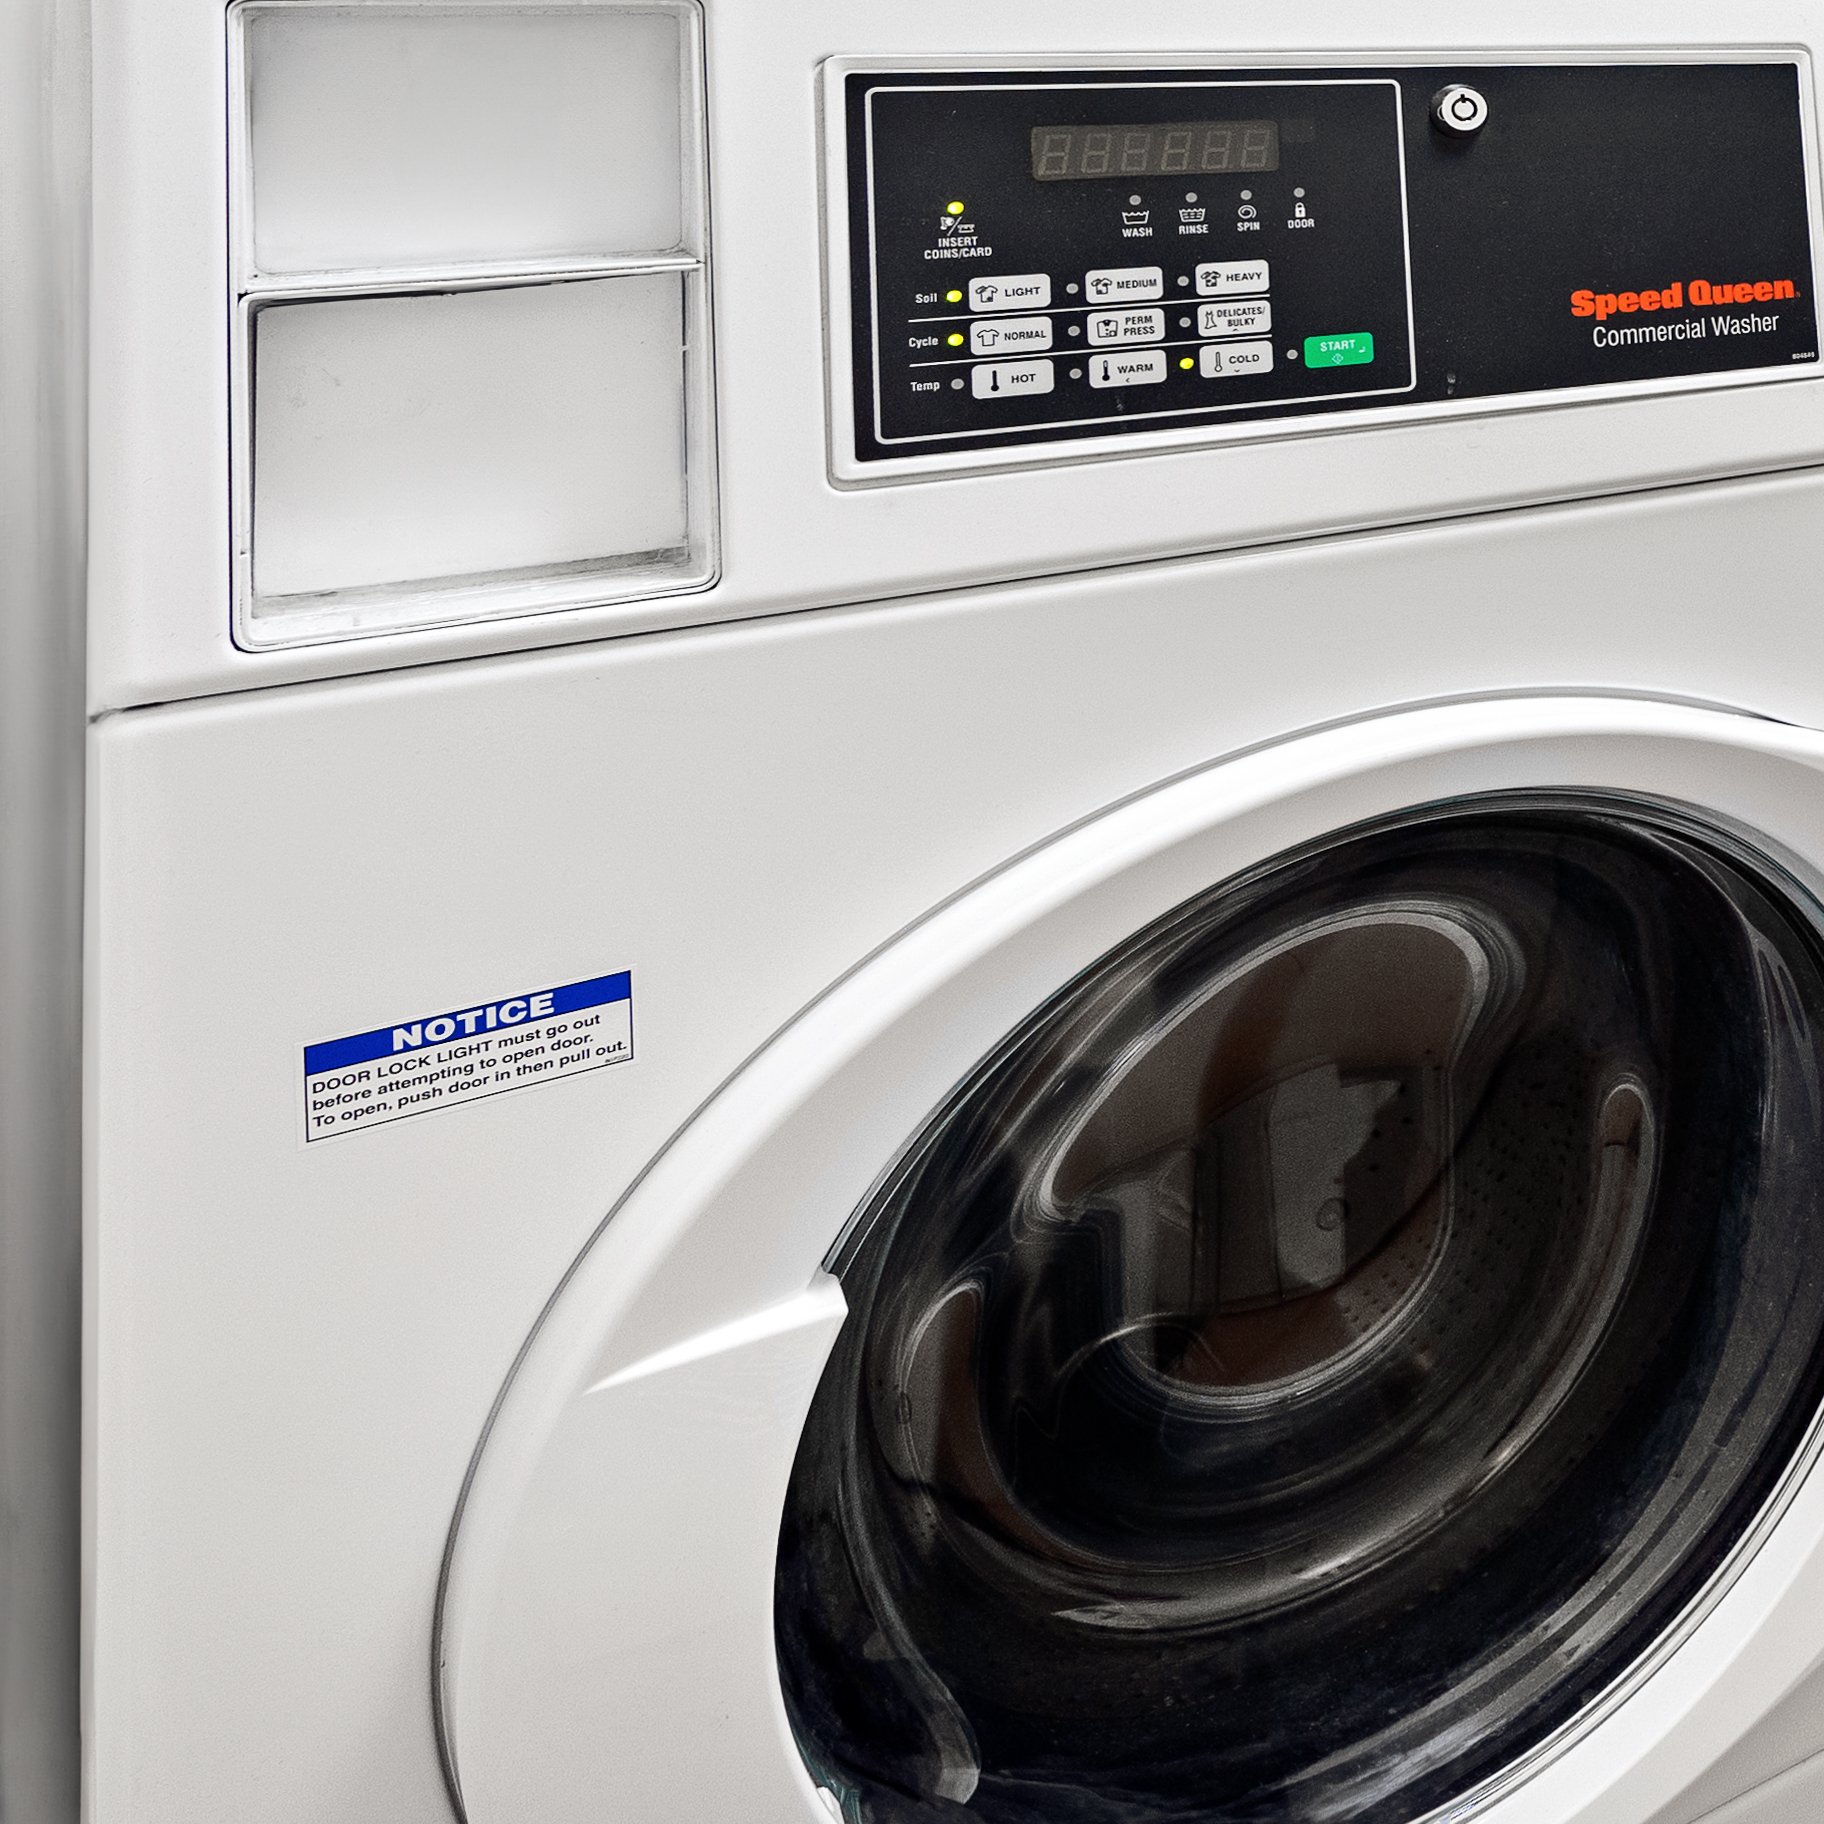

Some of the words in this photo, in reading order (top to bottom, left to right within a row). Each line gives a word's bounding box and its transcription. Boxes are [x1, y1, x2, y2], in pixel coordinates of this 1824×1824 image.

[1178, 223, 1209, 235] RINSE
[1236, 220, 1260, 232] SPIN
[1287, 218, 1315, 229] DOOR
[1121, 226, 1153, 238] WASH
[938, 236, 979, 248] INSERT
[924, 247, 993, 260] COINS/CARD
[1226, 271, 1263, 282] HEAVY
[1116, 278, 1158, 290] MEDIUM
[915, 292, 938, 304] Soil
[1004, 286, 1041, 298] LIGHT
[1570, 282, 1683, 320] Speed
[1688, 279, 1794, 307] Queen
[1216, 306, 1266, 319] DELICATES/
[1125, 315, 1153, 325] PERM
[1227, 317, 1257, 327] BULKY
[1004, 329, 1047, 341] NORMAL
[1123, 326, 1155, 336] PRESS
[1593, 317, 1706, 348] Commercial
[1712, 313, 1780, 337] Washer
[908, 336, 939, 350] Cycle
[1319, 340, 1356, 352] START
[1229, 353, 1260, 364] COLD
[1117, 363, 1154, 374] WARM
[1011, 373, 1036, 384] HOT
[910, 381, 940, 393] Temp
[392, 992, 555, 1051] NOTICE
[312, 1070, 370, 1094] DOOR
[377, 1055, 431, 1079] LOCK
[437, 1040, 493, 1064] LIGHT
[498, 1028, 541, 1049] must
[546, 1025, 568, 1043] go
[573, 1014, 600, 1031] out
[313, 1088, 372, 1111] before
[377, 1061, 474, 1096] attempting
[479, 1059, 496, 1073] to
[502, 1044, 545, 1068] open
[551, 1033, 594, 1052] door.
[312, 1113, 335, 1128] To
[341, 1100, 393, 1123] open,
[398, 1086, 443, 1110] push
[448, 1073, 490, 1094] door
[495, 1067, 511, 1082] in
[516, 1056, 554, 1077] then
[560, 1048, 591, 1071] pull
[595, 1041, 627, 1056] out.
